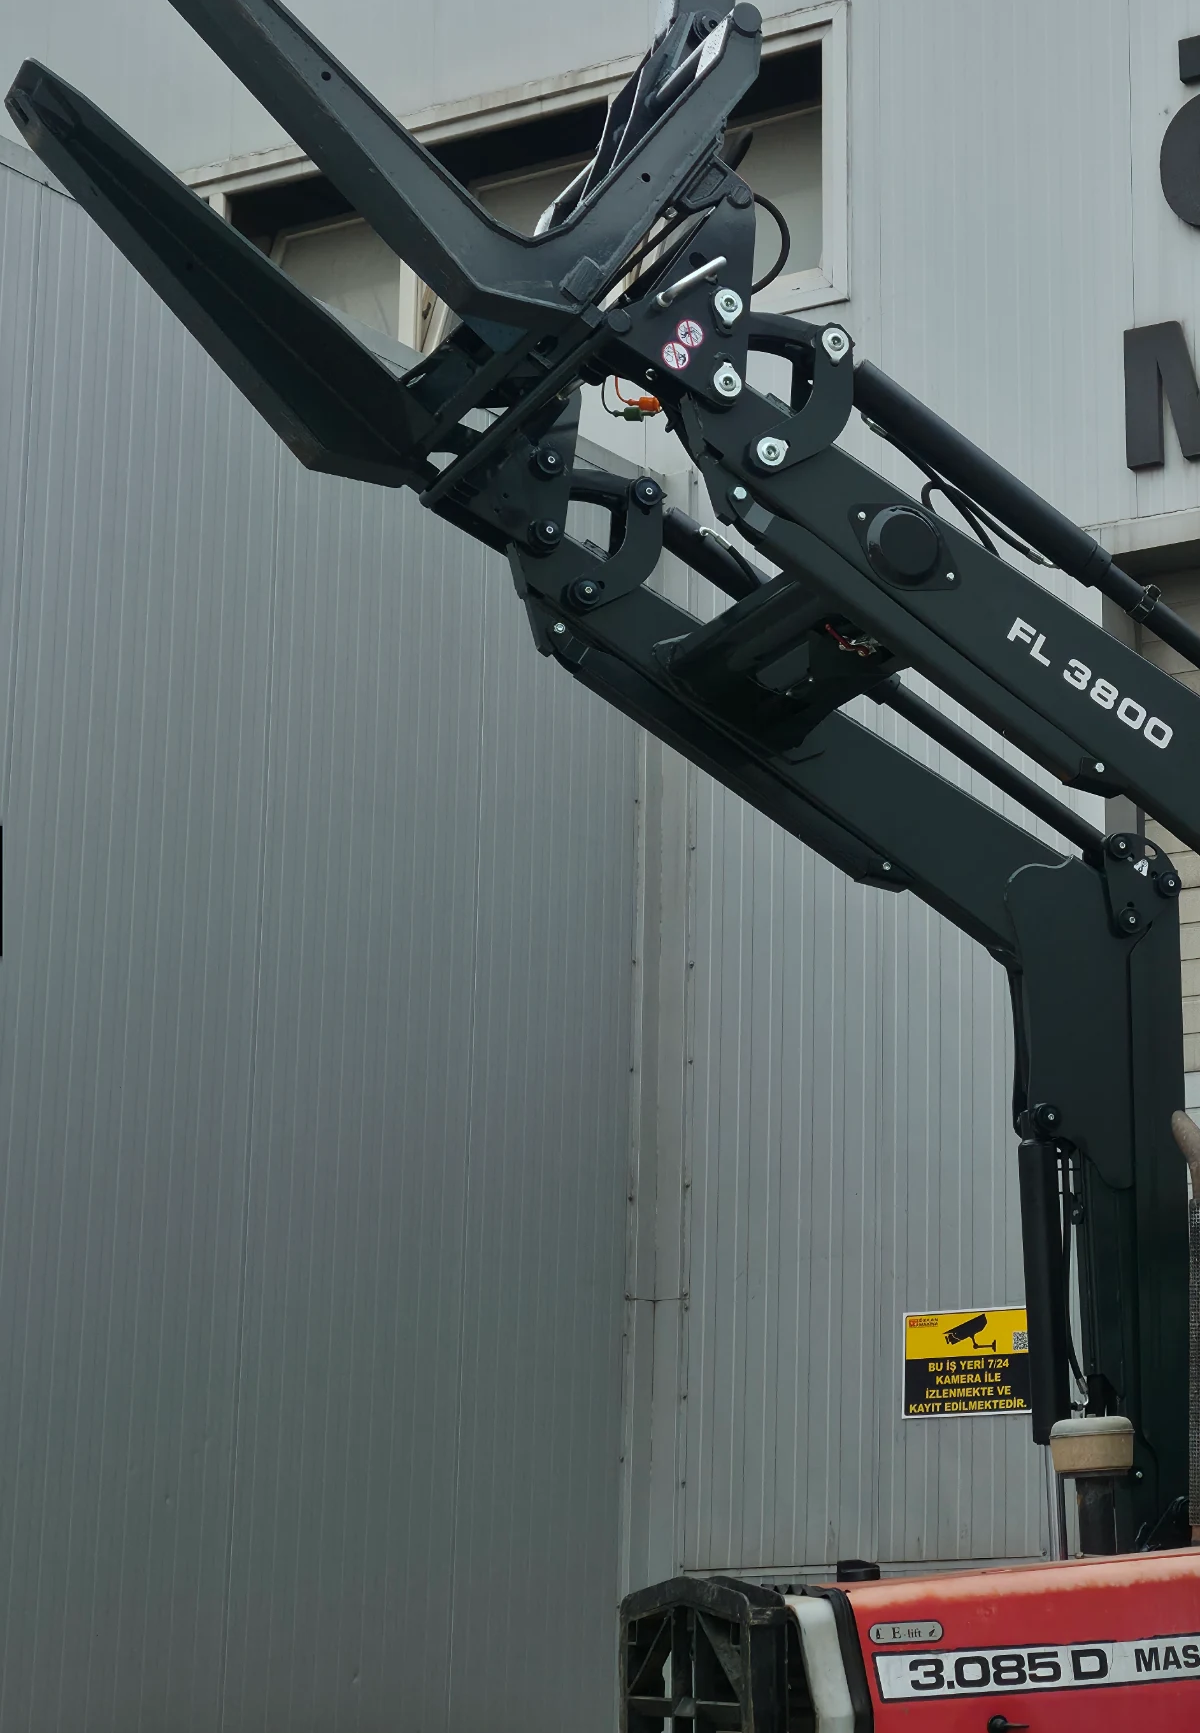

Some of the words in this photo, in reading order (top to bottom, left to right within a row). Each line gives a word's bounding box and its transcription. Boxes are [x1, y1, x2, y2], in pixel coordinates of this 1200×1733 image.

[1006, 617, 1051, 667] FL
[1063, 658, 1174, 749] 3800
[928, 1362, 943, 1372] BU
[946, 1360, 957, 1373] İŞ
[959, 1358, 985, 1370] YERİ
[988, 1358, 1009, 1369] 7/24
[936, 1374, 981, 1385] KAMERA
[985, 1371, 1001, 1383] İLE
[926, 1388, 994, 1399] İZLENMEKTE
[997, 1386, 1011, 1396] VE
[909, 1402, 941, 1413] KAYIT
[944, 1397, 1027, 1412] EDİLMEKTEDİR.
[909, 1651, 1061, 1691] 3.085
[1071, 1648, 1109, 1681] D
